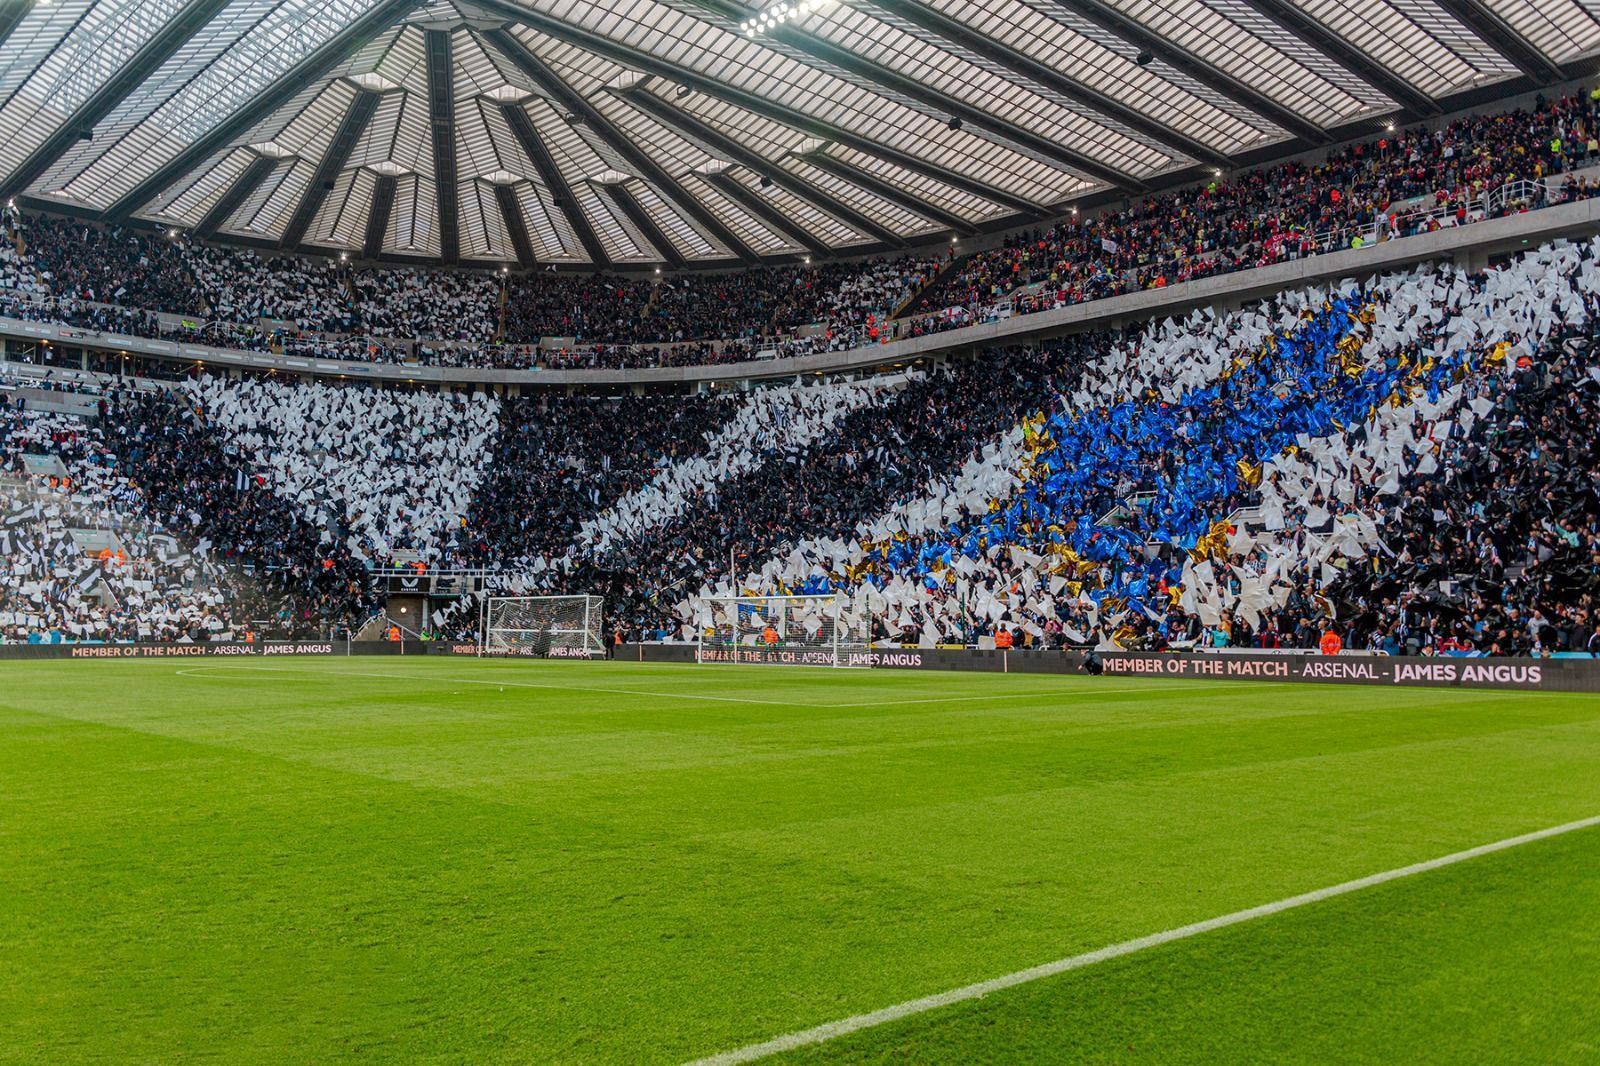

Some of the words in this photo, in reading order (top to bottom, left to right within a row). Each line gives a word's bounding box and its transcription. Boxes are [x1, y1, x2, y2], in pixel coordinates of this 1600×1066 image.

[72, 647, 121, 657] MEMBER
[123, 646, 139, 656] OF
[142, 646, 164, 656] THE
[166, 646, 206, 655] MATCH
[213, 646, 256, 655] ARSENAL
[263, 645, 294, 656] JAMES
[296, 644, 332, 653] ANGUS
[744, 651, 761, 662] THE
[882, 654, 922, 666] ANGUS
[1102, 658, 1163, 673] MEMBER
[1166, 659, 1188, 673] OF
[1191, 660, 1223, 675] THE
[1227, 661, 1288, 676] MATCH
[1302, 662, 1379, 679] ARSENAL
[1393, 664, 1457, 683] JAMES
[1460, 665, 1542, 683] ANGUS
